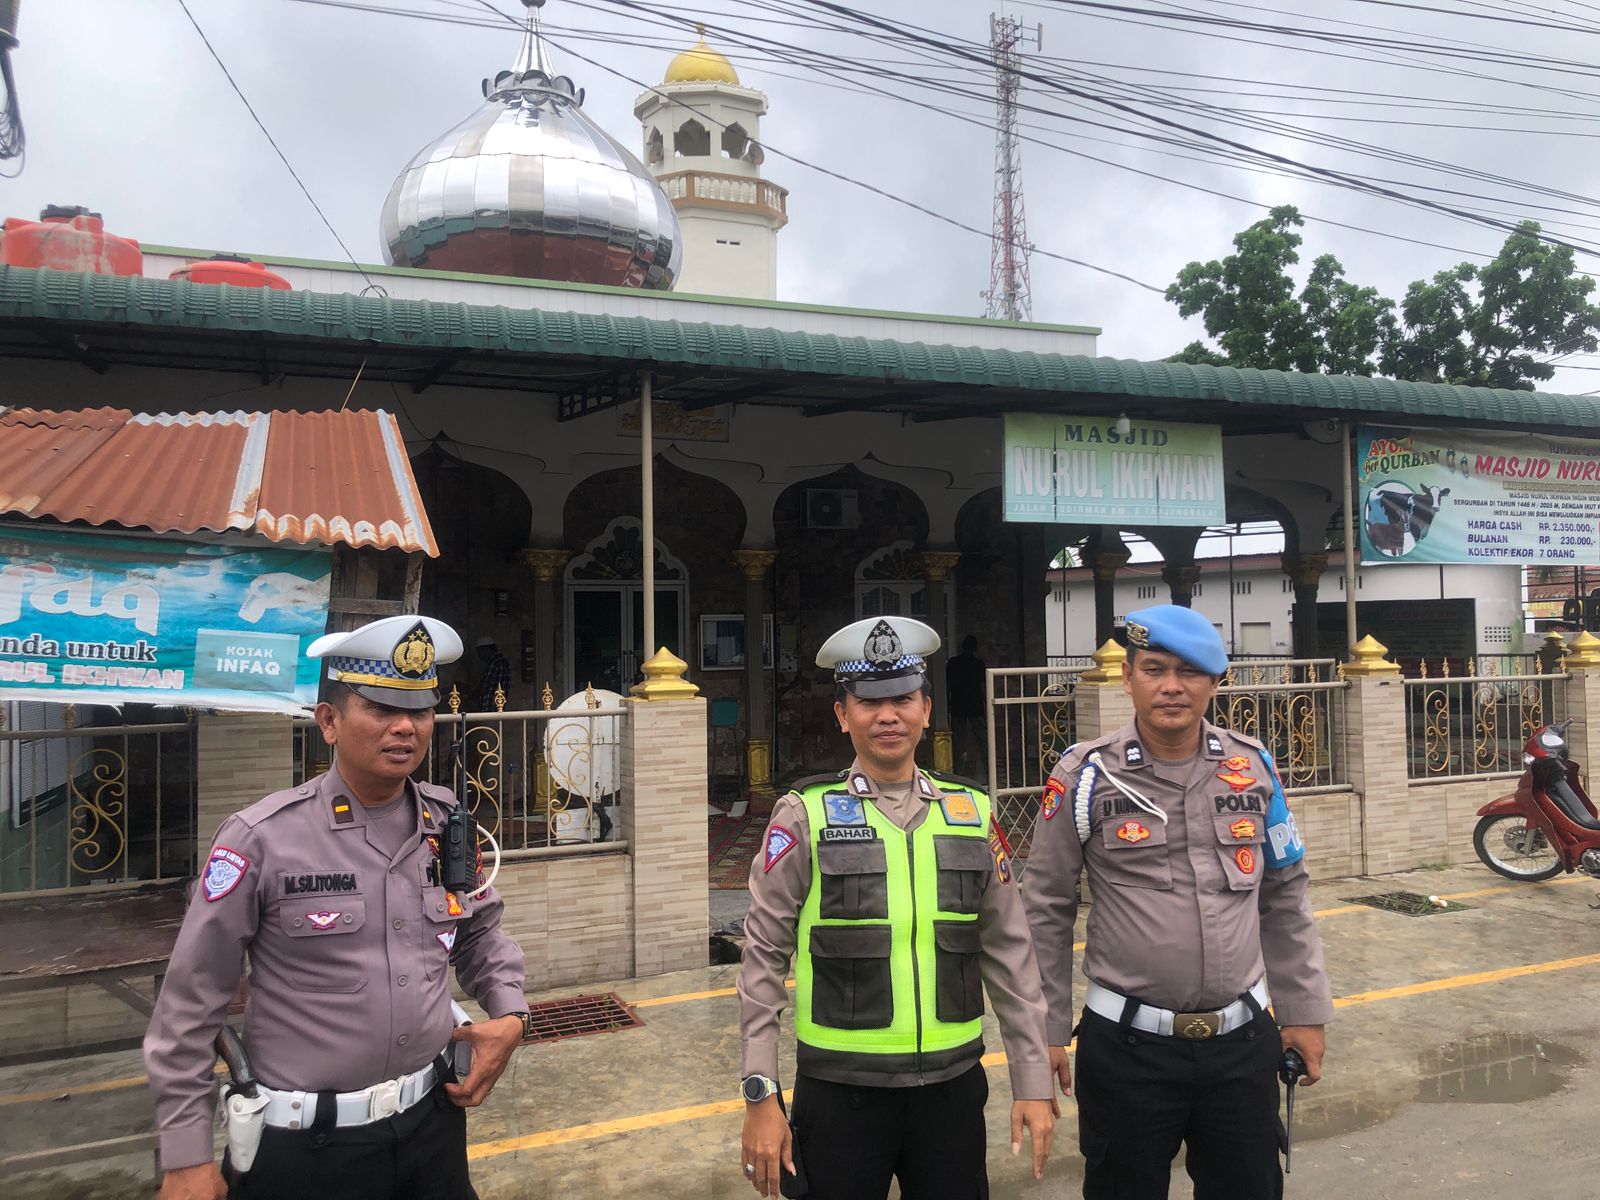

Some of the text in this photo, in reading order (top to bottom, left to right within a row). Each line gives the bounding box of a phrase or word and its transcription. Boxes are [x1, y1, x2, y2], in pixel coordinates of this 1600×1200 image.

[1064, 424, 1168, 447] MASJID
[1380, 449, 1440, 474] QURBAN
[1475, 455, 1551, 479] MASJID
[1013, 446, 1215, 501] NURUL IKHWAN
[1013, 503, 1046, 513] JALAN
[1467, 520, 1595, 533] HARGA CASH RP. 2.350.000,-
[1467, 533, 1596, 546] BULANAN RP. 230.000,-
[1468, 547, 1575, 558] KOLEKTIF/EKOR 7 ORANG
[66, 638, 159, 662] untuk
[226, 646, 274, 658] KOTAK
[216, 658, 281, 676] INFAQ
[62, 664, 185, 690] IKHWAN
[1214, 794, 1262, 813] POLRI
[825, 829, 871, 839] BAHAR
